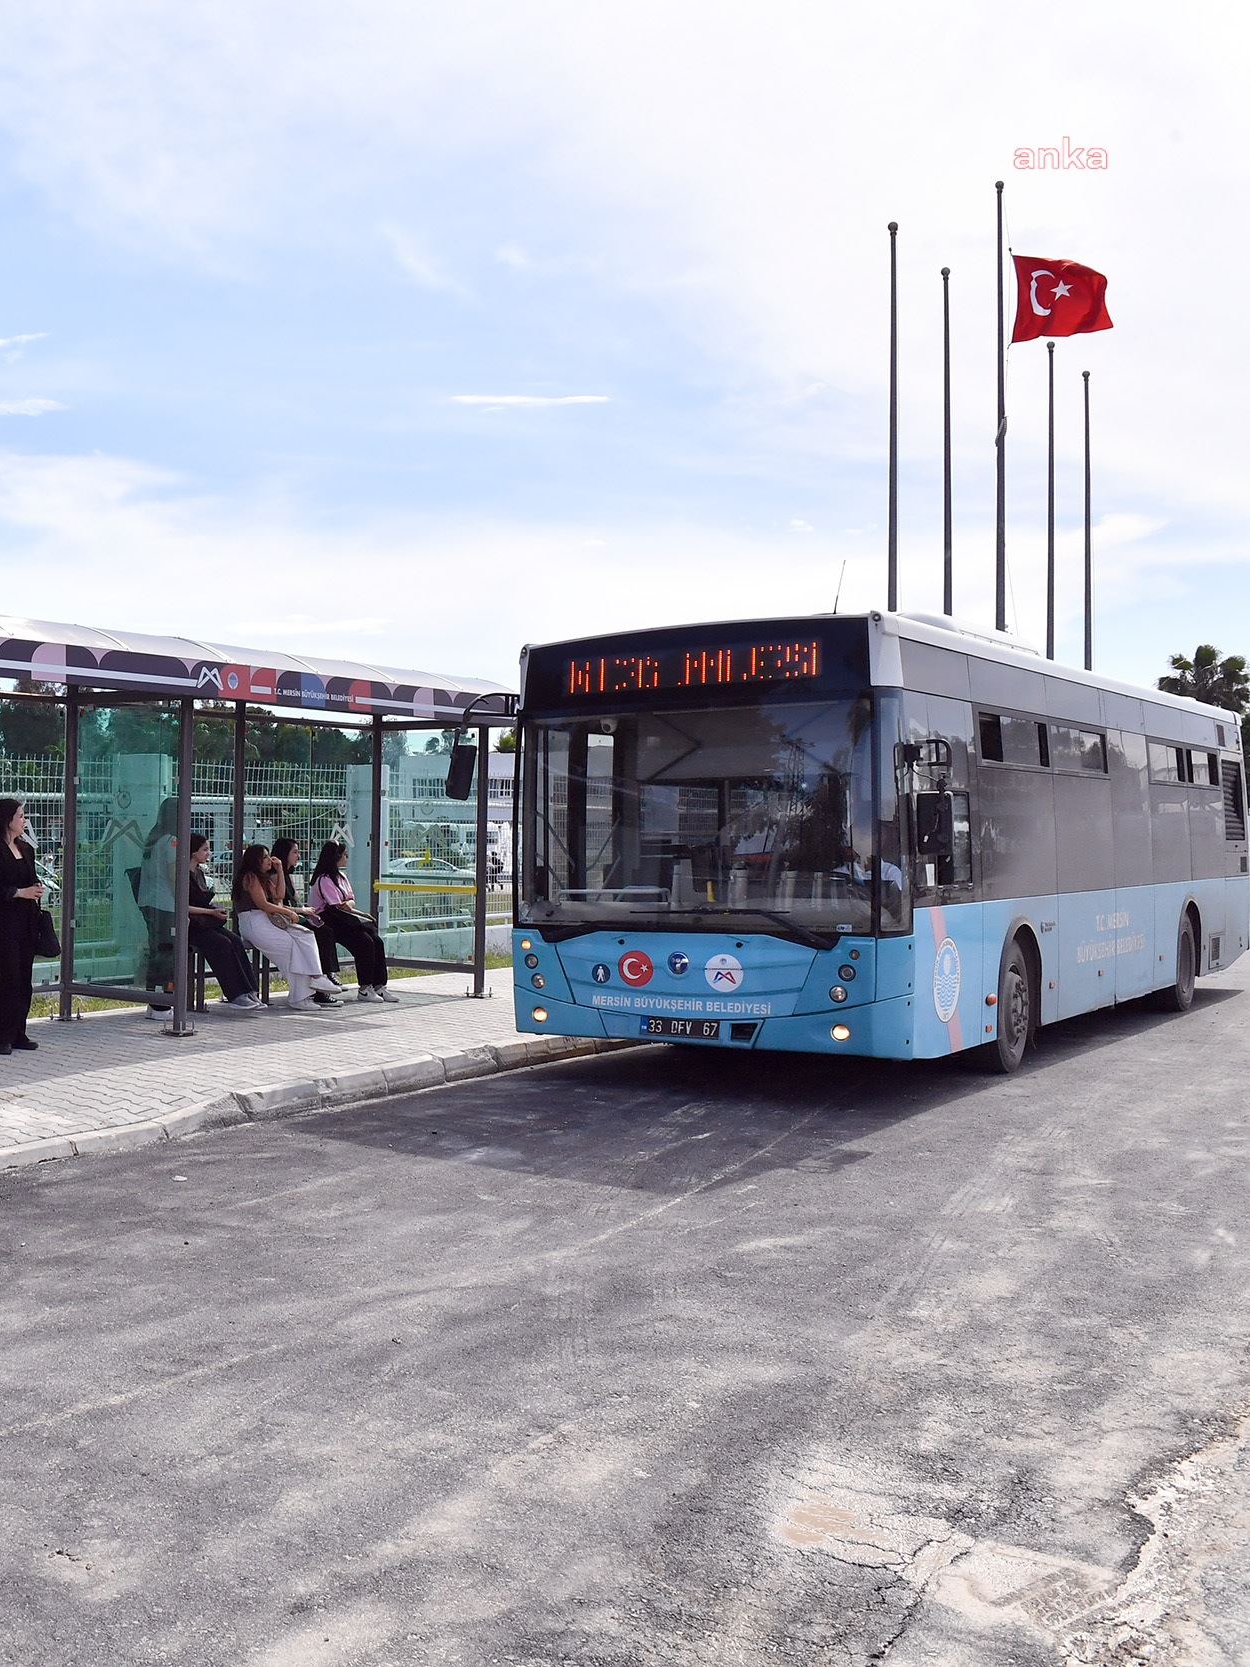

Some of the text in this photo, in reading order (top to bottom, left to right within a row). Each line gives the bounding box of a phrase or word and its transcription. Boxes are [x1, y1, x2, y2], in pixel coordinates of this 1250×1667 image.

[282, 688, 301, 697] MERSİN
[302, 689, 330, 700] BÜYÜKŞEHİR
[330, 693, 354, 703] BELEDİYESİ
[592, 994, 772, 1015] MERSİN BÜYÜKŞEHİR BELEDİYESİ
[648, 1019, 663, 1033] 33
[670, 1020, 693, 1035] DFV
[703, 1021, 718, 1036] 67
